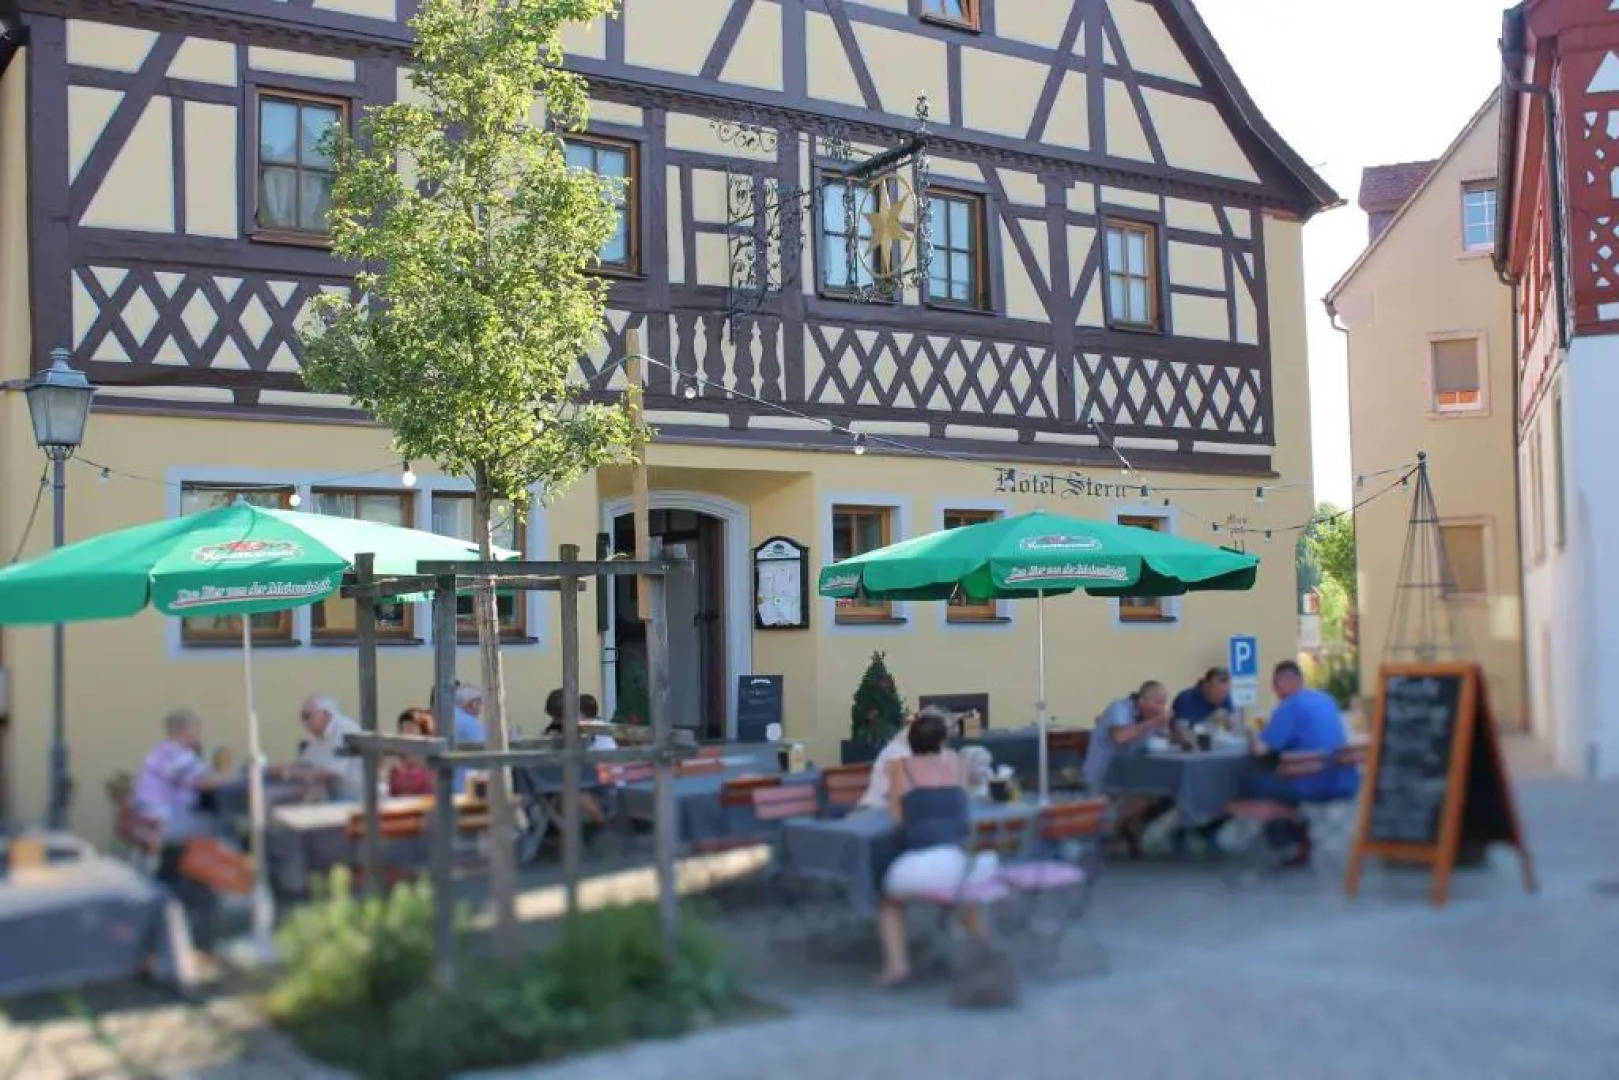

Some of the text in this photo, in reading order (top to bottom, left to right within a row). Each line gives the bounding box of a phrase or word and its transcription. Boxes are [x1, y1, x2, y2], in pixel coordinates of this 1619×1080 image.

[994, 467, 1126, 499] Hotel Stern
[1235, 641, 1250, 673] P
